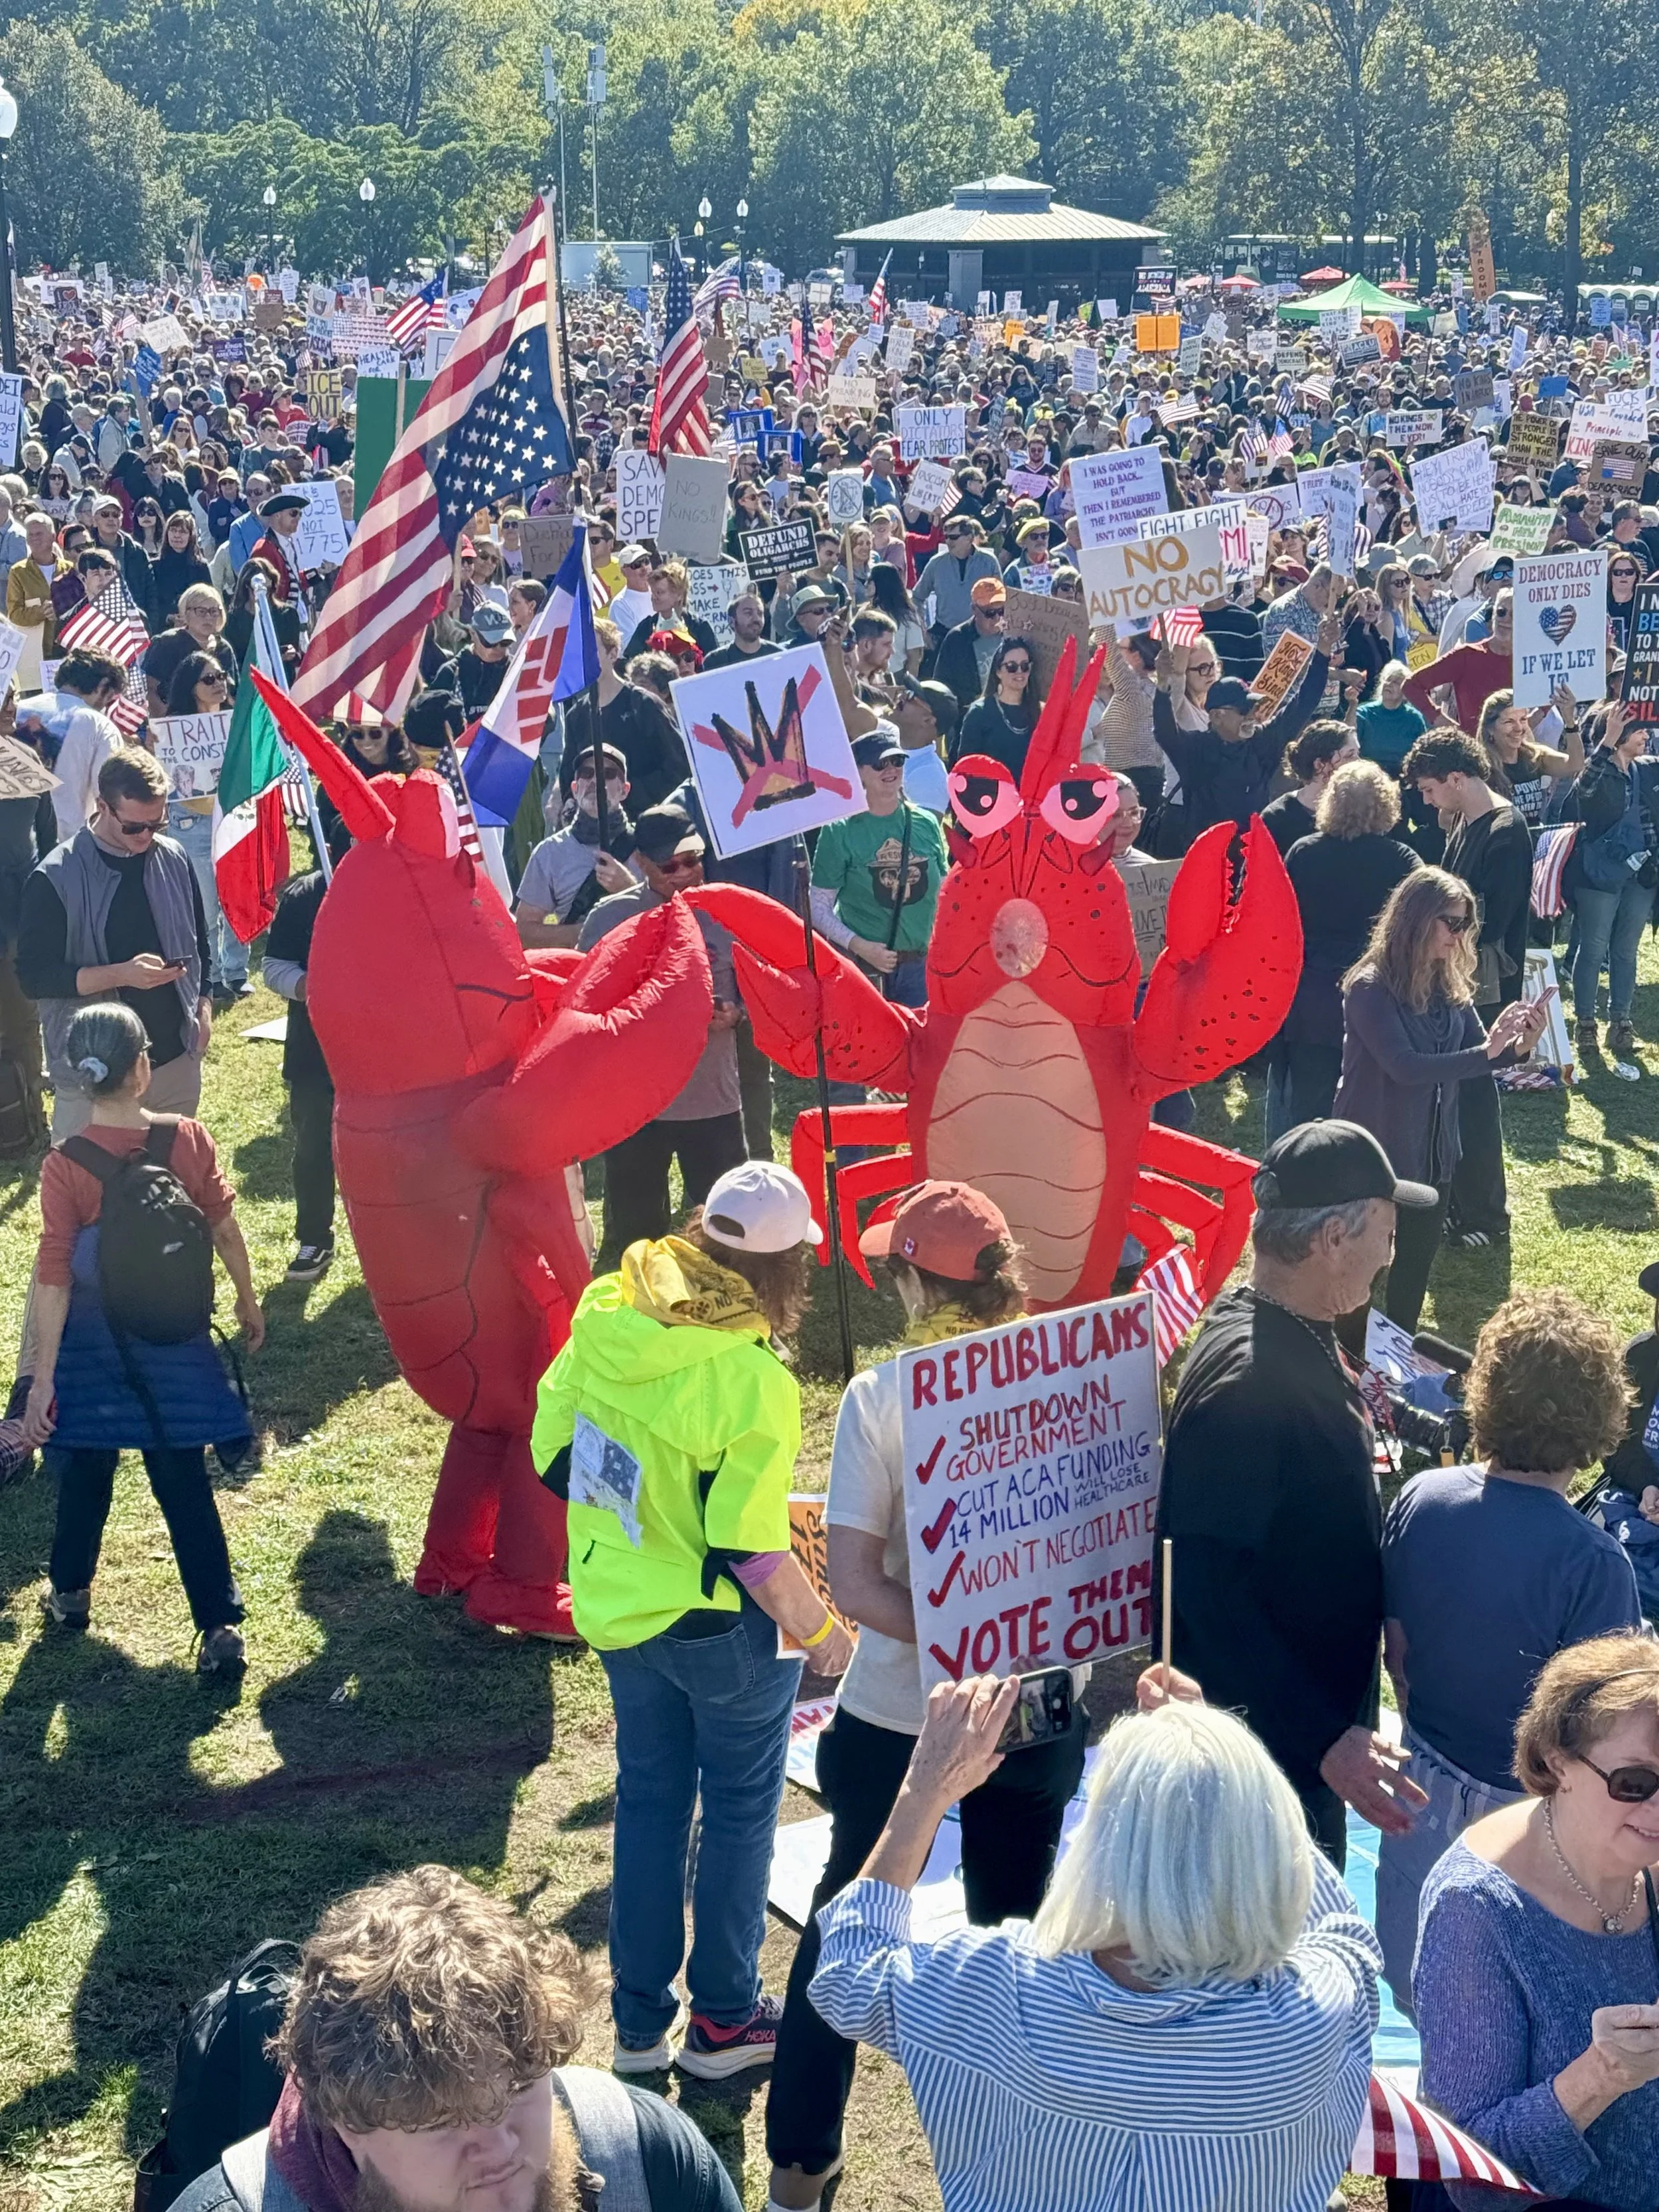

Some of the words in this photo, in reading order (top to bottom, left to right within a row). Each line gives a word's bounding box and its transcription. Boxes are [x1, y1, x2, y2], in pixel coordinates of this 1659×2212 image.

[1354, 338, 1375, 352] ACLU
[359, 351, 393, 365] HEALTH
[309, 372, 340, 395] ICE
[309, 396, 340, 419] OUT
[1608, 392, 1639, 406] FUCK
[914, 409, 951, 426] ONLY
[1400, 413, 1423, 423] KINGS
[1526, 414, 1548, 426] POWER
[1578, 404, 1595, 417] USA
[901, 423, 963, 440] DICTATORS
[1511, 431, 1557, 447] STRONGER
[1524, 424, 1547, 435] PEOPLE
[1586, 421, 1623, 437] Principle
[902, 440, 927, 457] FEAR
[930, 437, 966, 456] PROTEST
[1443, 443, 1479, 466] TRUMP
[1510, 443, 1531, 454] THAN
[1536, 447, 1553, 457] THE
[1595, 443, 1623, 459] SAVE
[1625, 445, 1646, 463] OUR
[622, 455, 662, 482] SAV
[1084, 469, 1088, 478] I
[1089, 465, 1107, 477] WAS
[1108, 460, 1133, 473] GOING
[1133, 457, 1145, 467] TO
[676, 480, 701, 497] NO
[918, 469, 947, 488] FASCISM
[1093, 477, 1115, 489] HOLD
[1588, 481, 1642, 496] DEMOCRACY
[622, 484, 665, 508] DEMO
[1110, 485, 1126, 497] BUT
[303, 498, 337, 517] 025
[668, 501, 717, 524] KINGS!!
[1082, 501, 1104, 516] THEN
[1105, 501, 1109, 510] I
[1111, 491, 1161, 509] REMEMBERED
[302, 519, 323, 532] NOT
[620, 509, 659, 536] SPE
[1090, 516, 1106, 528] THE
[1109, 506, 1155, 524] PATRIARCHY
[747, 525, 808, 550] DEFUND
[1095, 530, 1115, 542] ISN'T
[1118, 525, 1137, 538] GOIN
[1139, 515, 1185, 540] FIGHT
[297, 533, 344, 555] 1775
[749, 538, 810, 559] OLIGARCHS
[755, 566, 772, 576] FUND
[774, 564, 788, 573] THE
[788, 558, 814, 570] PEOPLE
[1122, 536, 1189, 579] NO
[719, 565, 747, 578] THIS
[1518, 558, 1603, 585] DEMOCRACY
[1089, 559, 1225, 619] AUTOCRACY
[1528, 585, 1559, 603] ONLY
[1561, 582, 1591, 599] DIES
[1635, 633, 1652, 650] TO
[1522, 655, 1538, 675] IF
[1540, 651, 1563, 671] WE
[1567, 648, 1597, 669] LET
[1632, 651, 1659, 663] GRAN
[1628, 684, 1659, 702] NOT
[155, 713, 227, 747] TRAIT
[161, 747, 176, 756] TO
[181, 741, 226, 762] CONST
[945, 1325, 957, 1335] NO
[912, 1301, 1151, 1411] REPUBLICANS
[959, 1373, 1112, 1452] SHUTDOWN
[946, 1399, 1126, 1483] GOVERNMENT
[956, 1480, 997, 1518] CUT
[1006, 1465, 1054, 1498] ACA
[1056, 1430, 1151, 1481] FUNDING
[1074, 1471, 1151, 1511] HEALTHCARE
[950, 1523, 970, 1549] 14
[979, 1486, 1070, 1541] MILLION
[1074, 1477, 1106, 1494] WILL
[1111, 1462, 1141, 1483] LOSE
[958, 1536, 1041, 1595] WON'T
[1046, 1496, 1157, 1564] NEGOTIATE
[1069, 1558, 1151, 1615] THEM
[928, 1595, 1052, 1682] VOTE
[1062, 1595, 1151, 1660] OUT
[744, 2029, 776, 2043] HOKA
